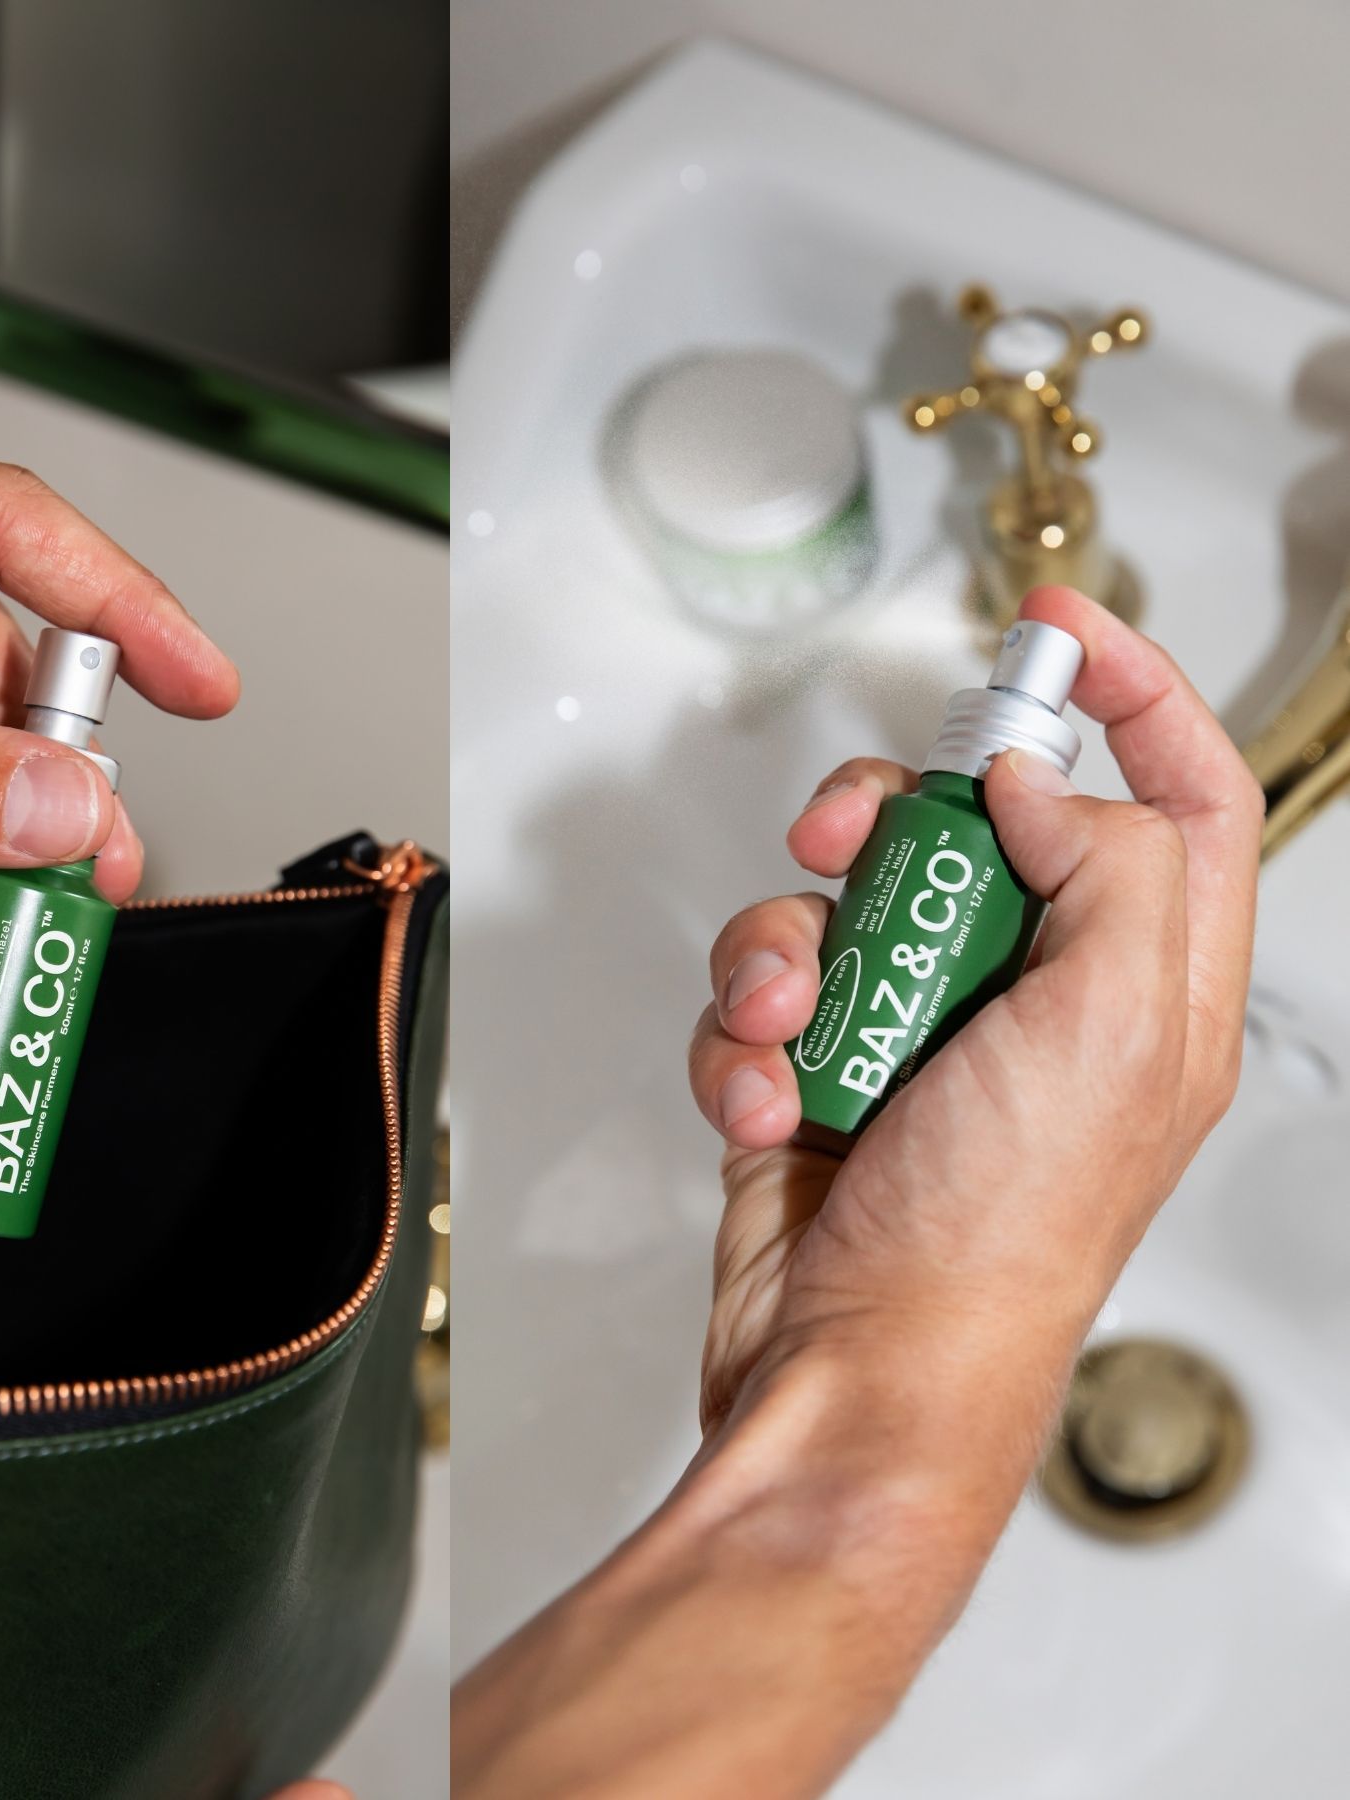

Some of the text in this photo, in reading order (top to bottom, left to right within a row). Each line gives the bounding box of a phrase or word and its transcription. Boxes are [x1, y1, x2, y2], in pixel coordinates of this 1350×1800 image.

[854, 841, 897, 930] Basil, Vetiver
[866, 837, 911, 933] and Witch Hazel
[949, 923, 971, 957] 50ml
[969, 890, 983, 908] 1.7
[982, 866, 995, 882] oz
[59, 1002, 75, 1036] 50ml
[73, 966, 83, 983] 1.7
[82, 938, 91, 955] oz
[802, 959, 850, 1057] Naturally Fresh
[812, 1000, 844, 1060] Deodorant
[839, 979, 925, 1099] BAZ
[890, 943, 943, 981] &
[899, 1027, 930, 1081] Skincare
[921, 975, 951, 1026] Farmers
[9, 1029, 55, 1067] &
[18, 1056, 61, 1195] The Skincare Farmers
